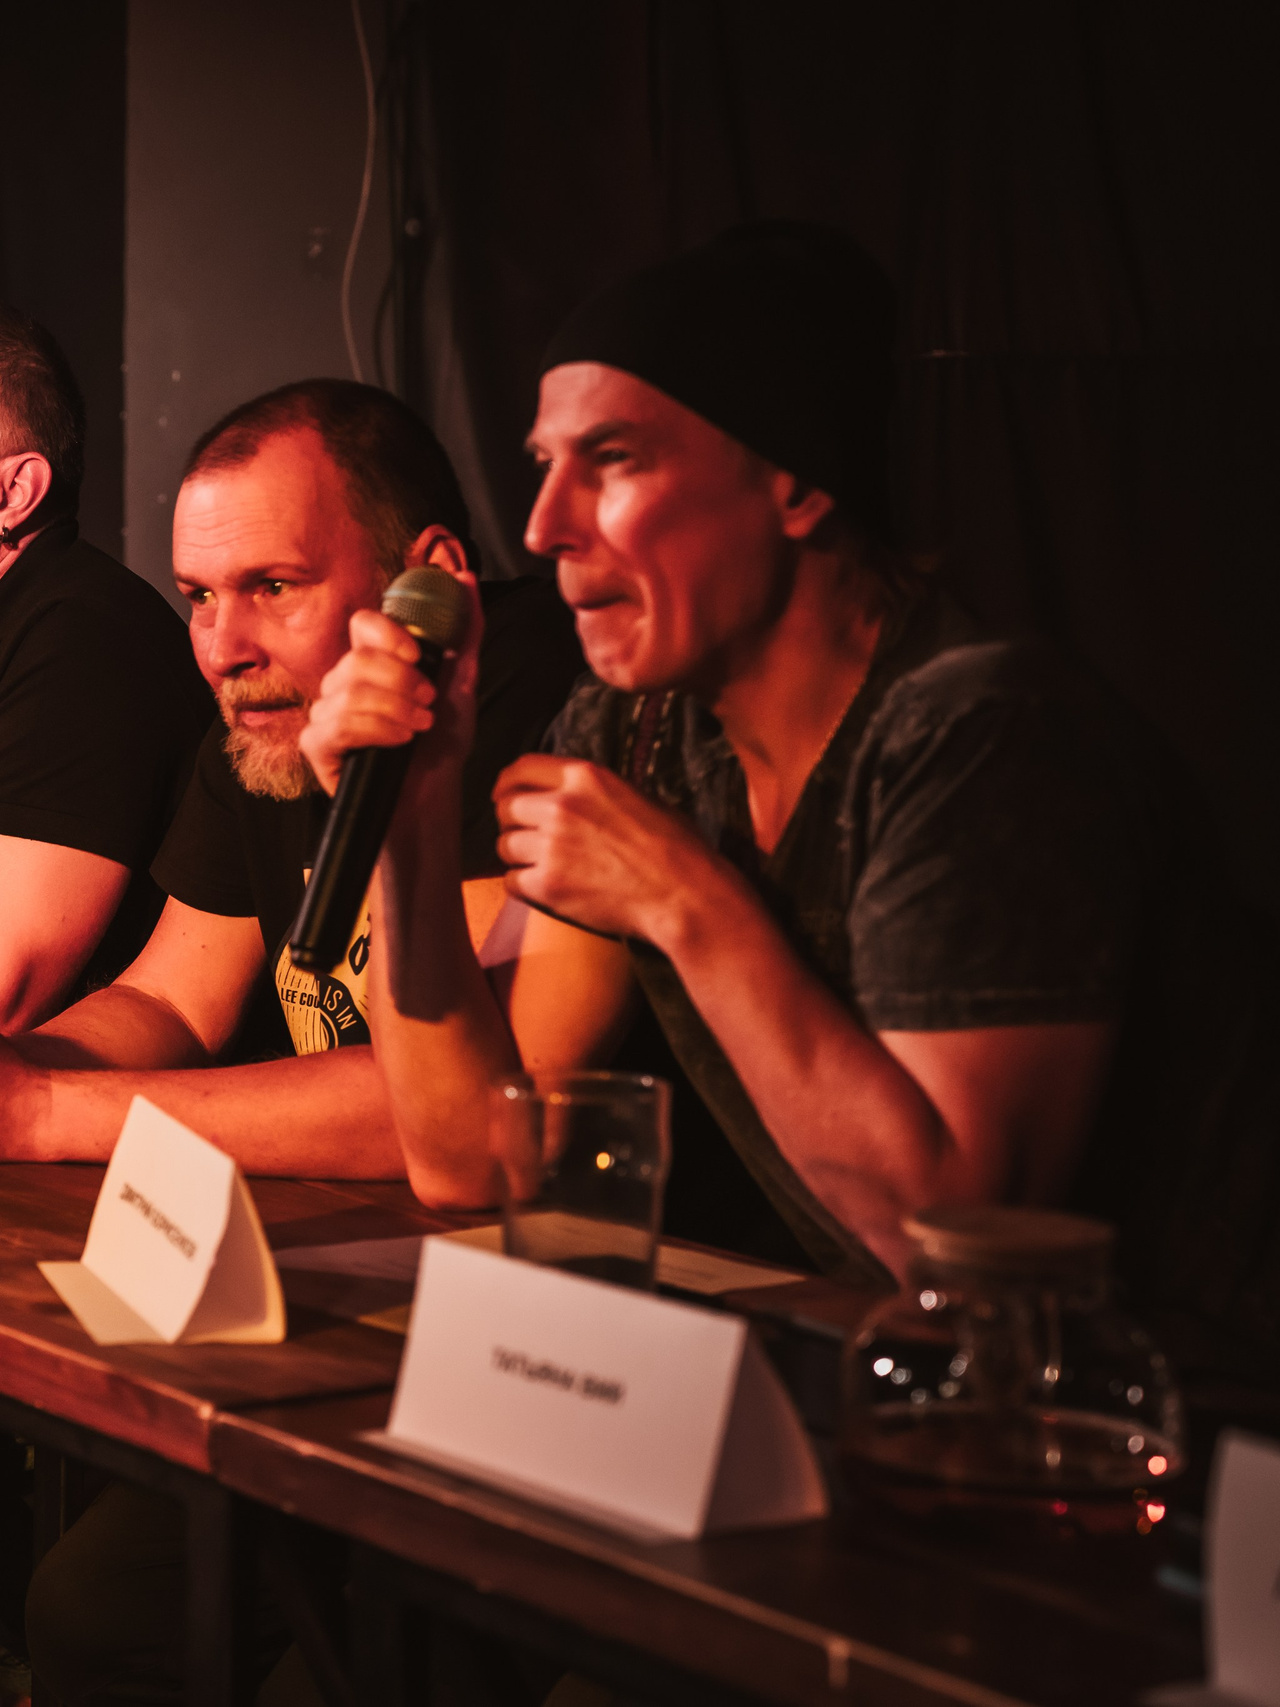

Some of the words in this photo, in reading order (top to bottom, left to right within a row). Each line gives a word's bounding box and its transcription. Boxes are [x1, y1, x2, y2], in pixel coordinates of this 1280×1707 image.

[281, 987, 298, 1004] LEE
[324, 985, 343, 1011] IS
[336, 1005, 357, 1030] IN
